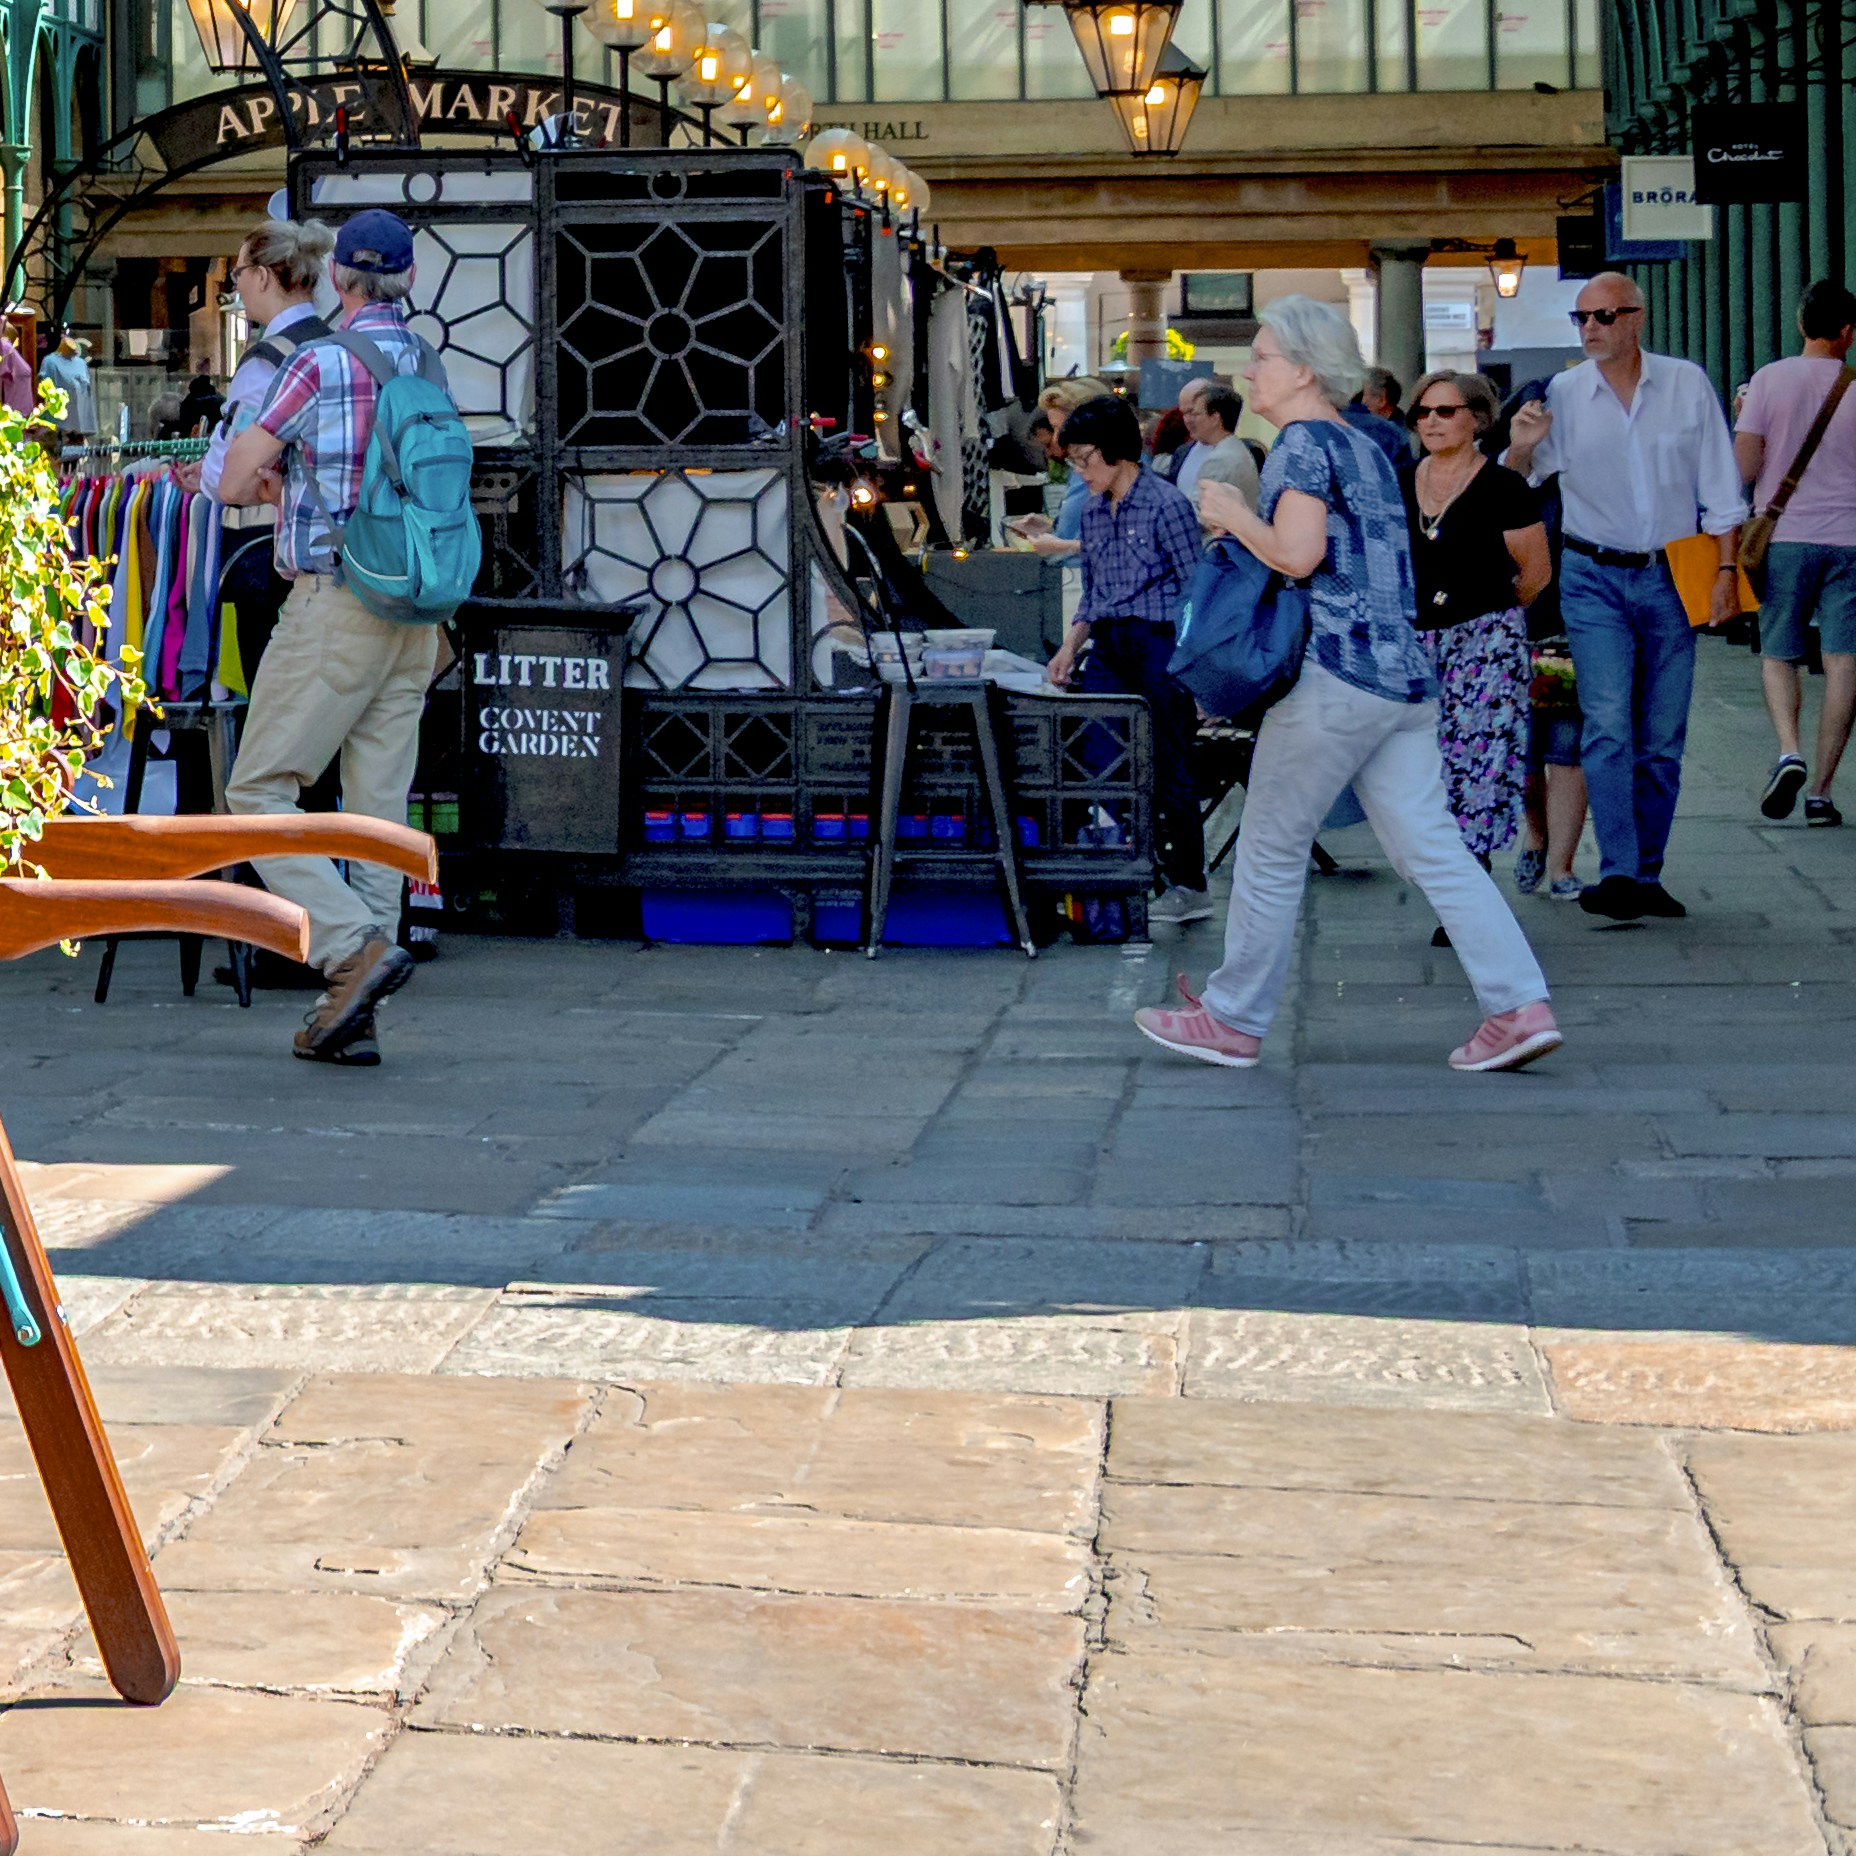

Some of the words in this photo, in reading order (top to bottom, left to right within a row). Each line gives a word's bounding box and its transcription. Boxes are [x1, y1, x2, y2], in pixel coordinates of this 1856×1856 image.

[408, 82, 621, 142] MARKET
[863, 121, 929, 140] HALL
[473, 653, 610, 690] LITTER
[479, 707, 601, 733] COVENT
[478, 731, 601, 757] GARDEN
